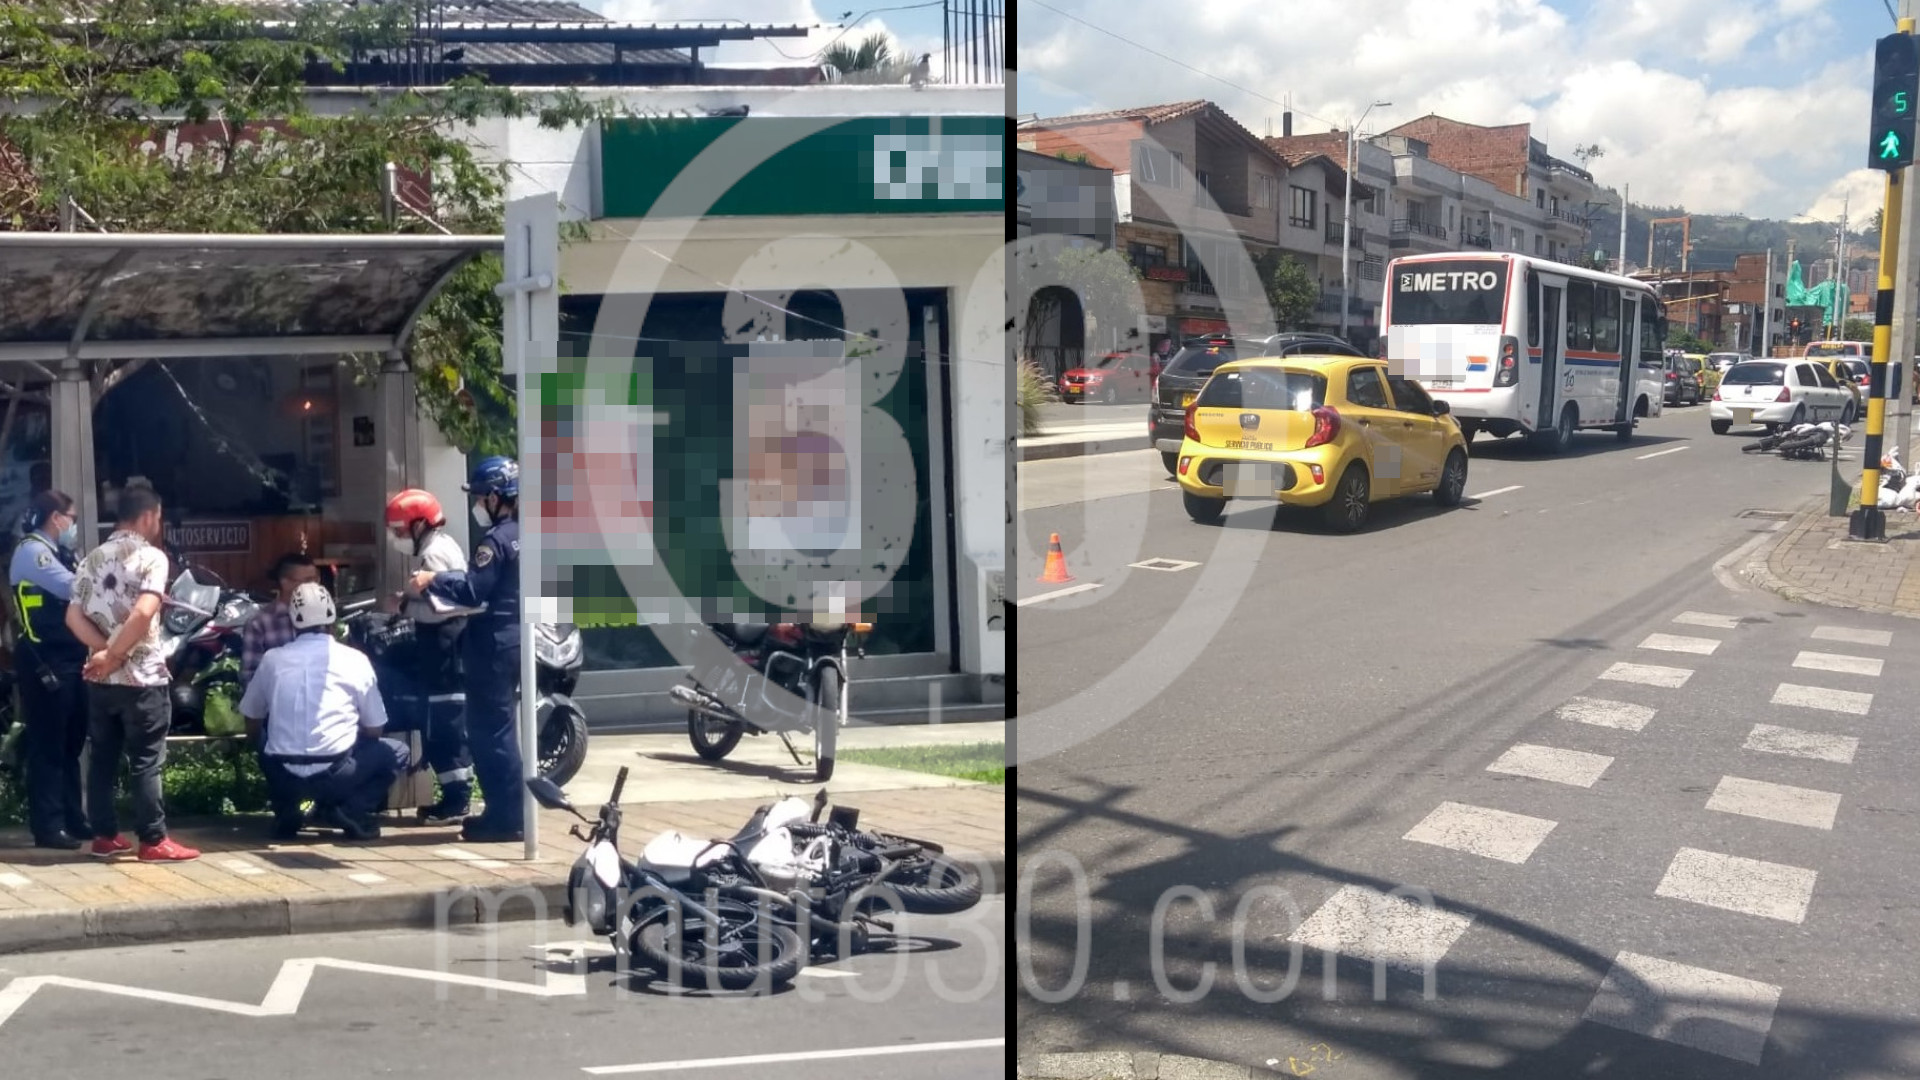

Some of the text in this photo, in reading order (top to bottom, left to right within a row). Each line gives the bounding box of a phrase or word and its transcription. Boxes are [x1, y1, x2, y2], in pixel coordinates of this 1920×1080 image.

[1895, 91, 1907, 112] 5
[1413, 271, 1498, 292] METRO
[167, 526, 247, 546] AUTOSERVICIO
